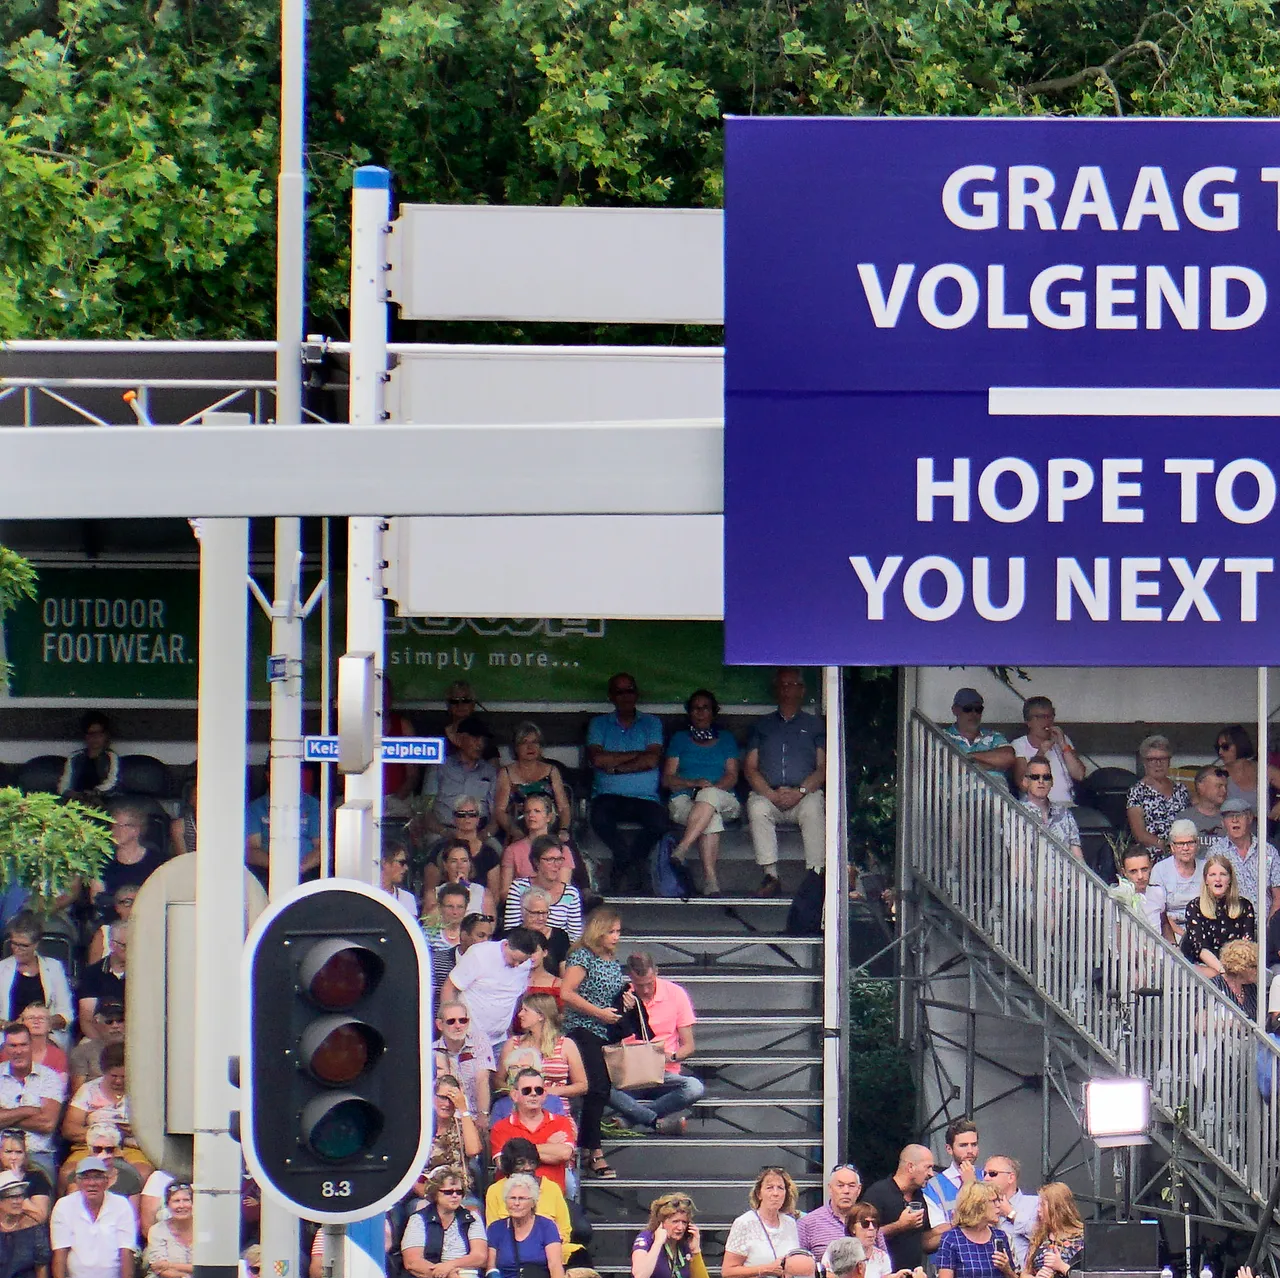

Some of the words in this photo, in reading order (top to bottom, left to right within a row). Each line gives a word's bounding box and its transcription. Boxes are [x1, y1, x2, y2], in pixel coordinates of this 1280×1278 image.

[941, 165, 1239, 232] GRAAG
[856, 263, 1267, 331] VOLGEND
[916, 457, 1144, 523] HOPE
[1164, 458, 1276, 524] TO
[43, 598, 165, 628] OUTDOOR
[848, 556, 1025, 622] YOU
[1056, 557, 1274, 622] NEXT
[43, 632, 195, 664] FOOTWEAR.
[390, 647, 474, 671] simply
[321, 1180, 352, 1197] 8.3
